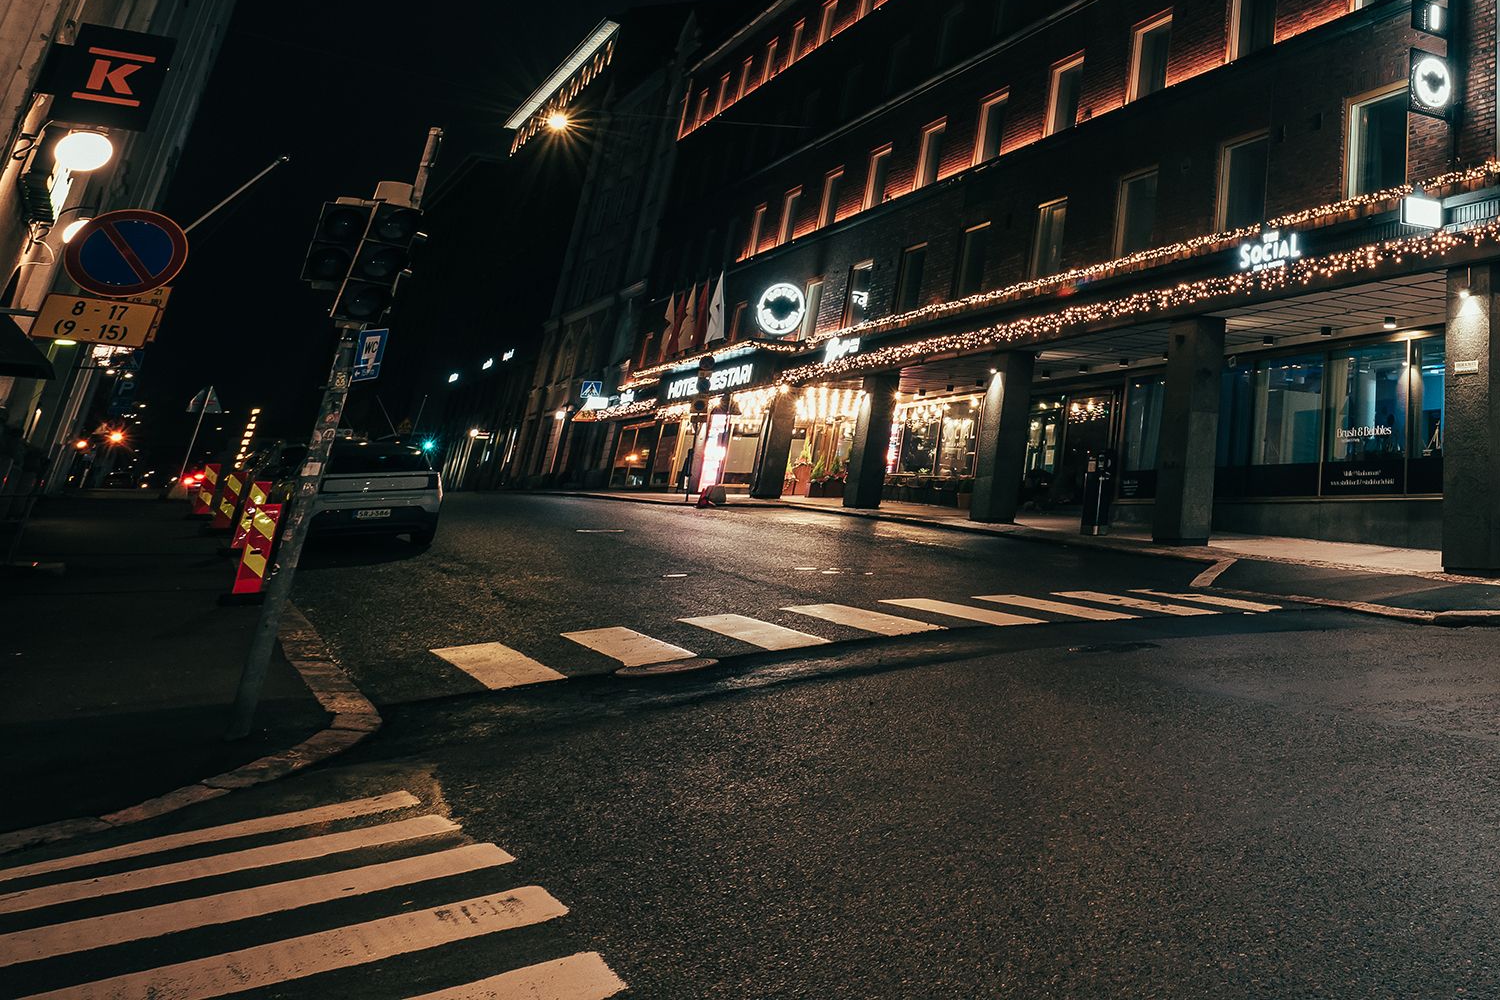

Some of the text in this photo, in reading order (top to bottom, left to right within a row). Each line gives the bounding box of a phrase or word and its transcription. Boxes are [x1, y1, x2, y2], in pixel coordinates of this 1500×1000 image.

[86, 59, 142, 94] K
[1239, 233, 1301, 268] SOCIAL
[72, 301, 86, 316] 8
[108, 305, 129, 320] 17
[53, 319, 77, 335] (9
[98, 324, 128, 341] 15)
[364, 341, 379, 354] WC
[1336, 426, 1357, 438] Brush
[1363, 425, 1392, 437] Bubbles
